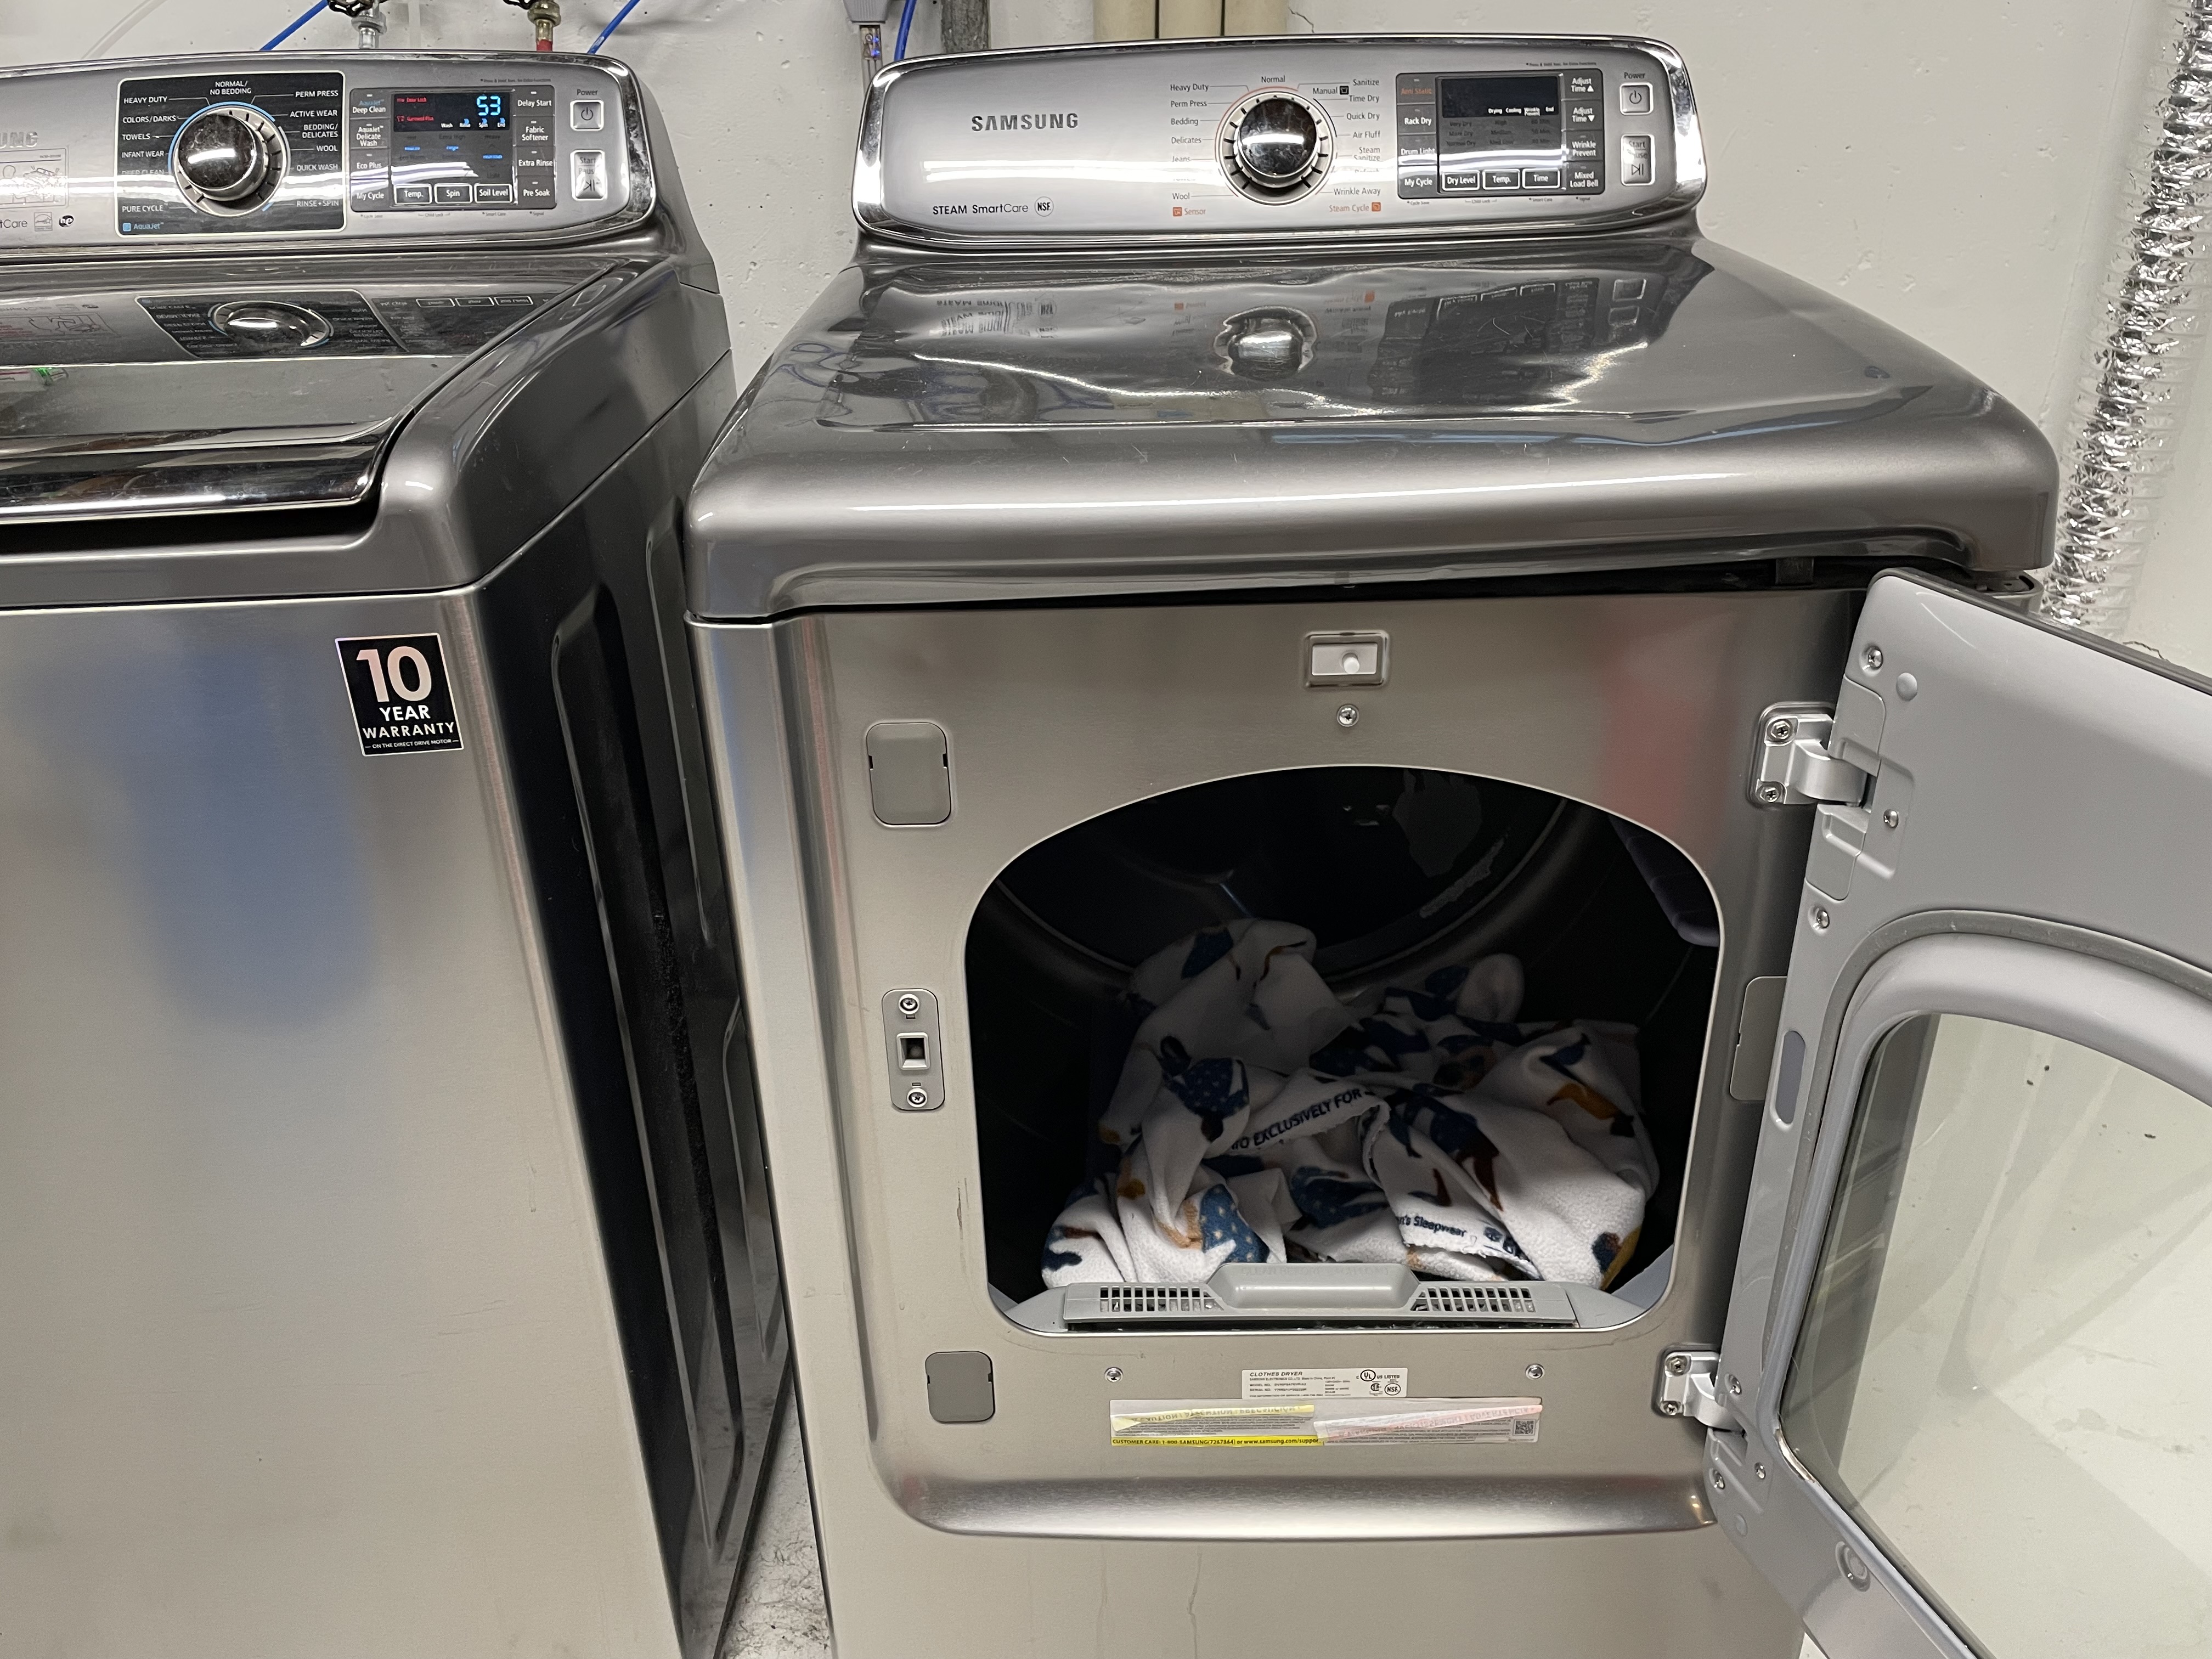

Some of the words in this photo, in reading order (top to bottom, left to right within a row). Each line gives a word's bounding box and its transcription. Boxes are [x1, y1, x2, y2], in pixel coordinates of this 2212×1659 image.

[1572, 77, 1592, 86] Adjust
[1367, 94, 1380, 103] Dry
[476, 95, 501, 116] 53
[517, 99, 535, 108] Delay
[1573, 107, 1593, 116] Adjust
[122, 115, 176, 123] COLORS/DARKS
[1368, 112, 1380, 121] Dry
[972, 113, 1078, 131] SAMSUNG
[1404, 117, 1420, 125] Rack
[1420, 117, 1432, 126] Dry
[1572, 140, 1596, 148] Wrinkle
[1629, 140, 1646, 148] Start
[1533, 174, 1549, 182] Time
[1575, 171, 1594, 179] Mixed
[1404, 178, 1414, 187] My
[1416, 178, 1433, 187] Cycle
[1447, 177, 1459, 186] Dry
[1460, 176, 1476, 184] Level
[1492, 176, 1511, 184] Temp.
[368, 192, 384, 200] Cycle
[446, 190, 460, 198] Spin
[1361, 187, 1381, 196] Away
[933, 205, 967, 215] STEAM
[972, 204, 1029, 214] SmartCare
[1352, 204, 1369, 212] Cycle
[357, 646, 432, 702] 10
[379, 705, 431, 721] YEAR
[362, 722, 454, 739] WARRANTY
[1253, 1099, 1331, 1147] EXCLUSIVELY
[1334, 1088, 1362, 1108] FOR
